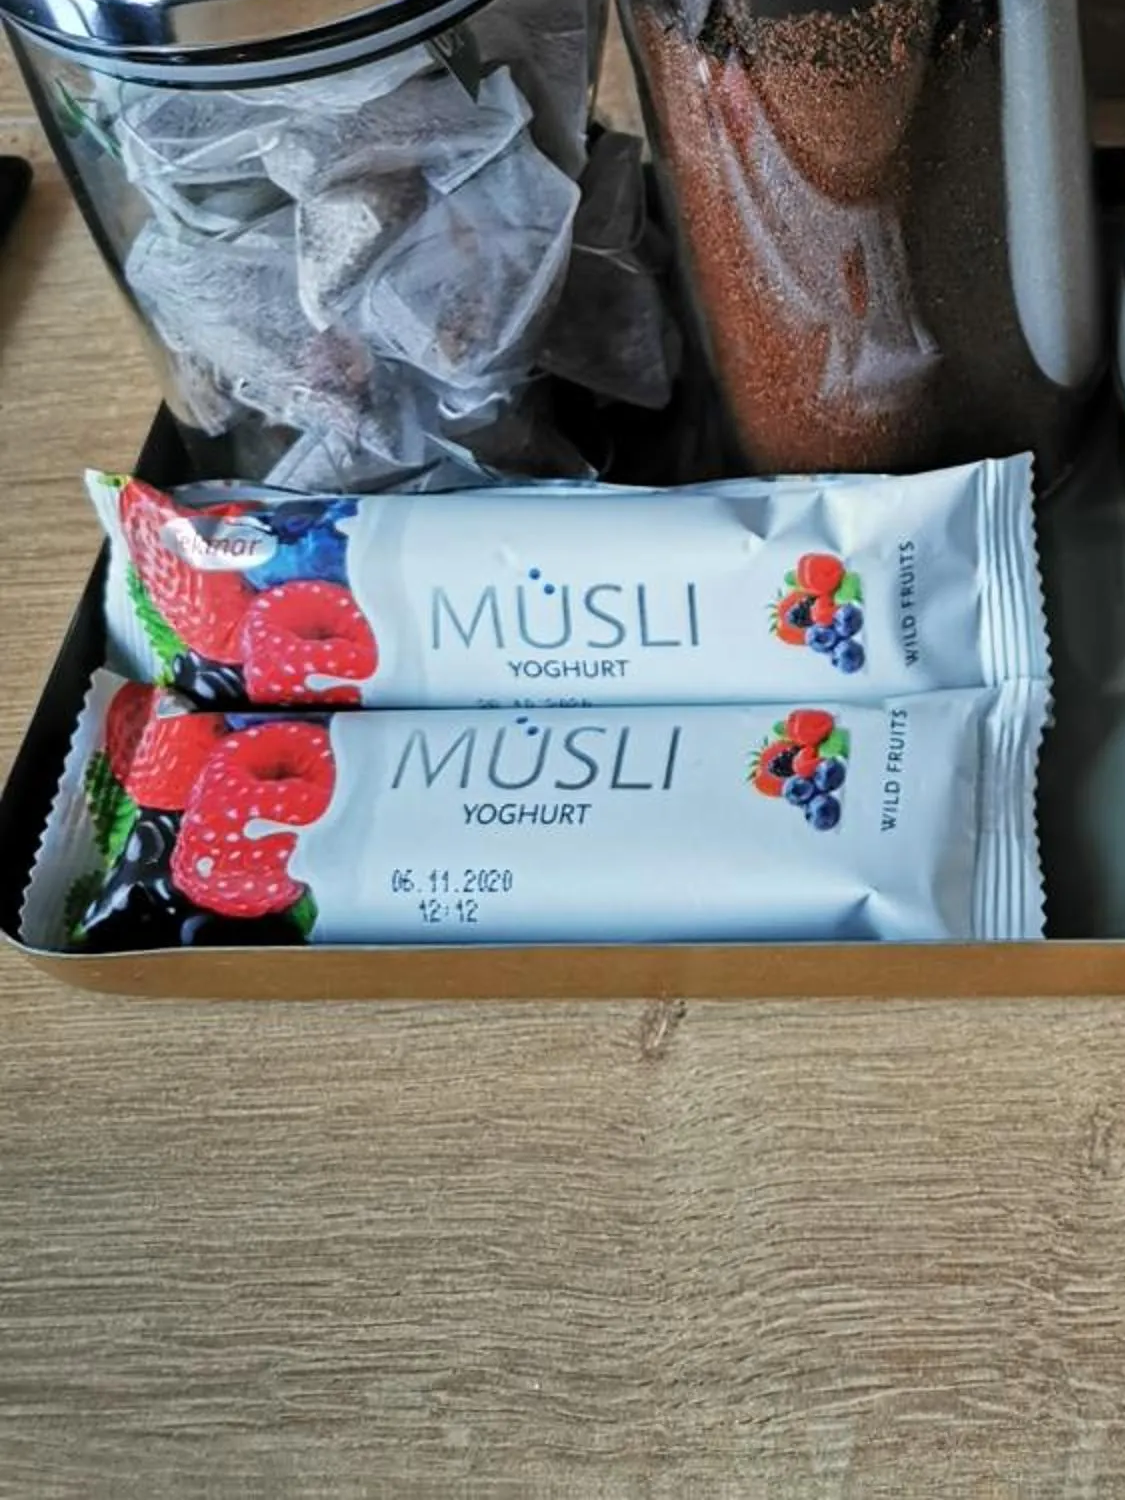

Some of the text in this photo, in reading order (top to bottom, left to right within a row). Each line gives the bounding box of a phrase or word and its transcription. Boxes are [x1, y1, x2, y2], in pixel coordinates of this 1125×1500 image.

[431, 567, 699, 650] MÜSLI
[899, 540, 919, 667] WILD FRUITS
[507, 659, 628, 678] YOGHURT
[391, 716, 682, 790] MÜSLI
[880, 708, 908, 832] WILD FRUITS
[463, 803, 592, 825] YOGHURT
[391, 869, 513, 893] 06.11.2020
